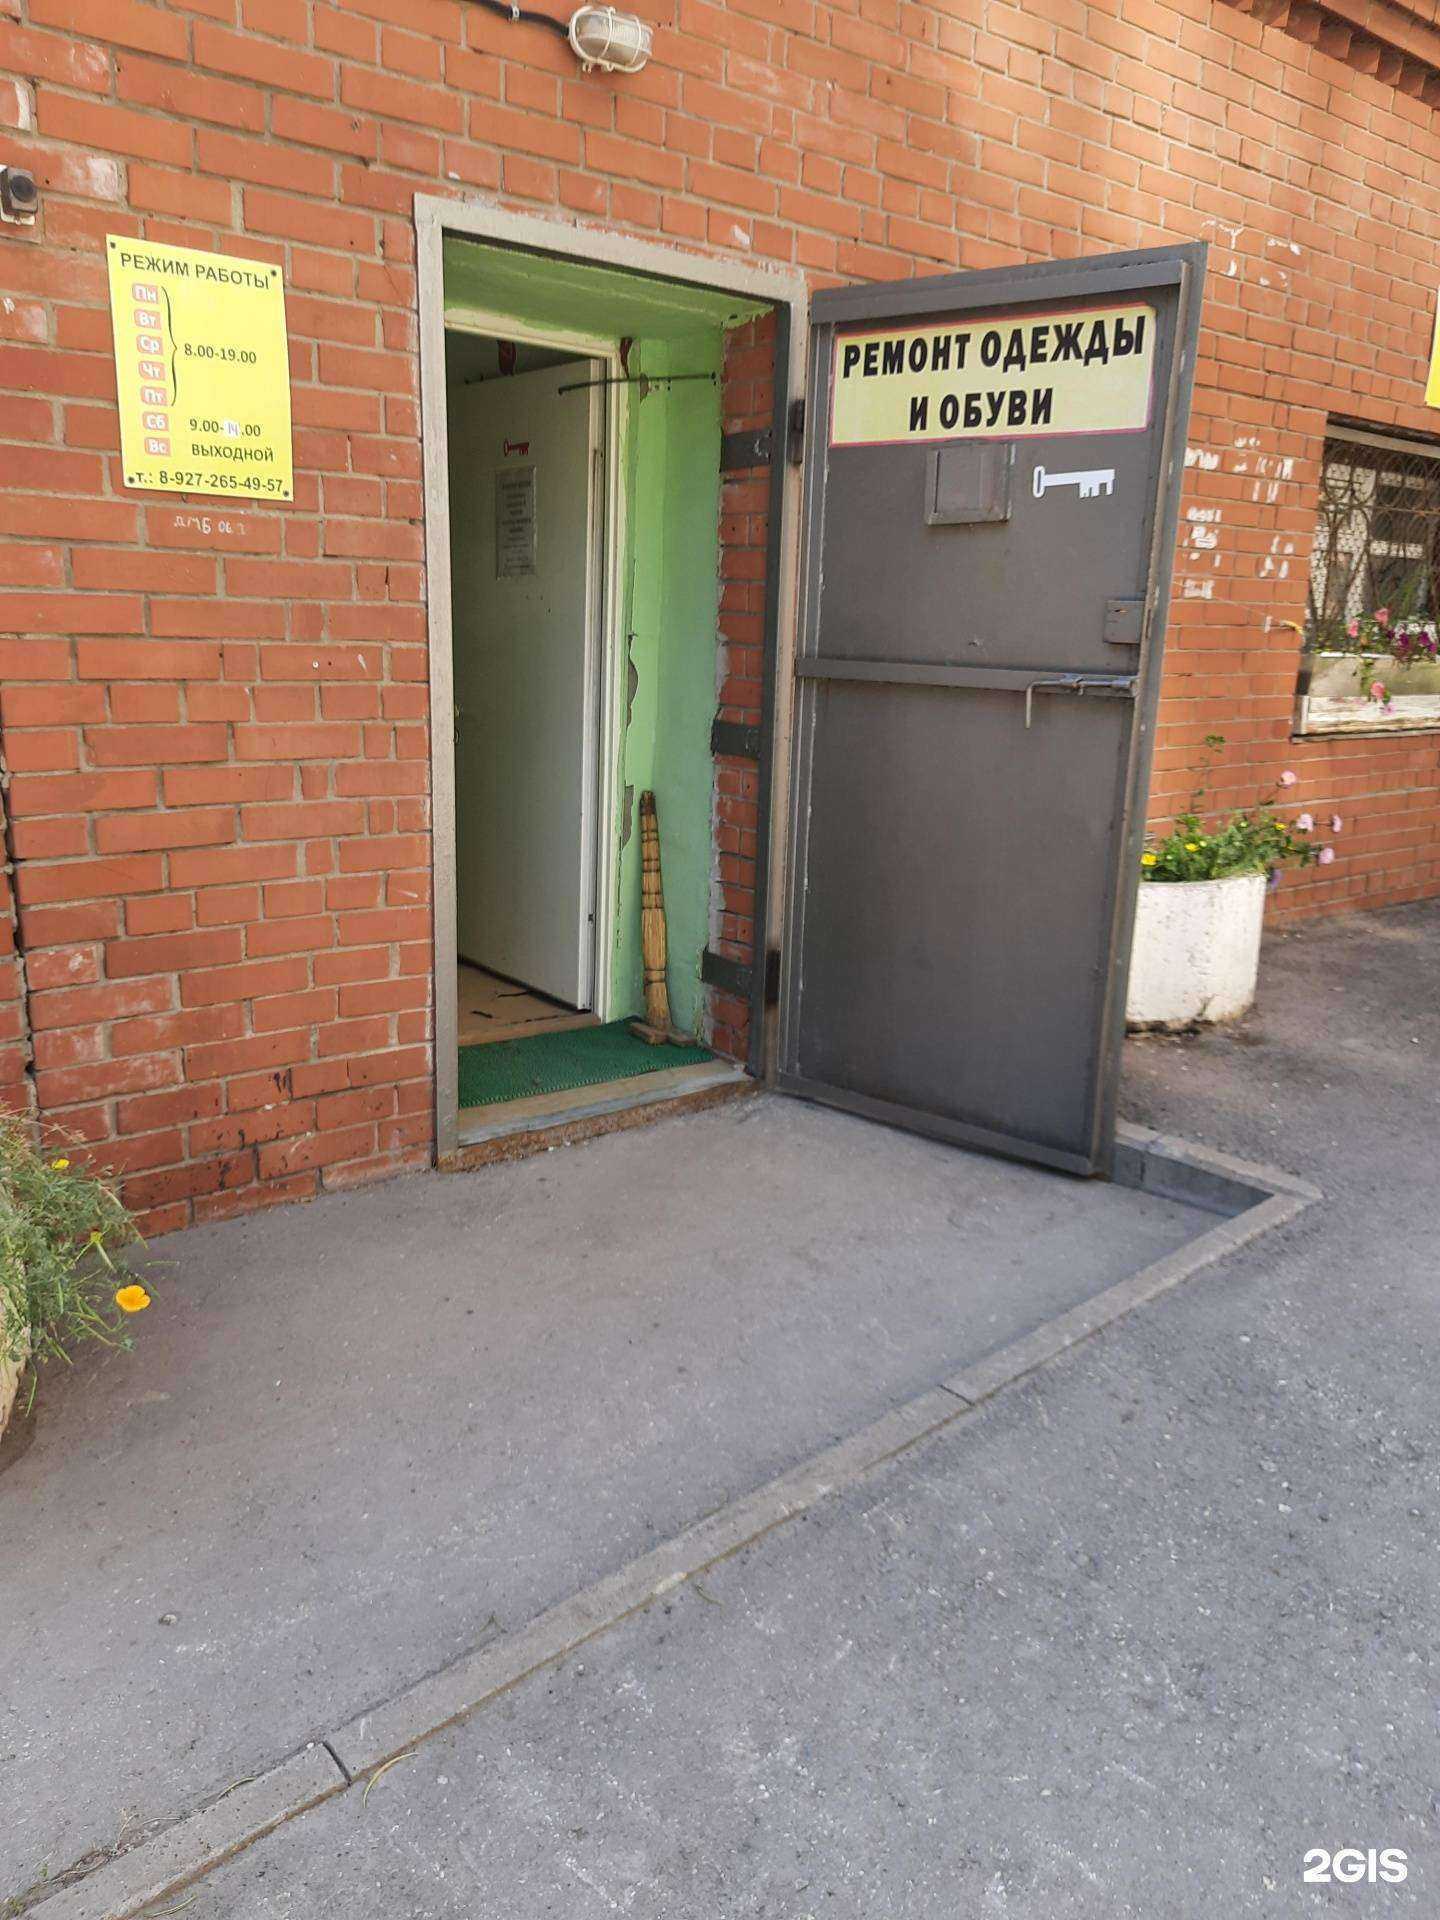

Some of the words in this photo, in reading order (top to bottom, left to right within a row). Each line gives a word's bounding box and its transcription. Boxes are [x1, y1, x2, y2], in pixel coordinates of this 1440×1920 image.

[120, 252, 190, 277] РЕЖИМ
[195, 264, 270, 290] РАБОТЫ
[135, 285, 157, 302] Пн
[139, 310, 158, 327] Вт
[140, 336, 160, 354] Ср
[184, 343, 257, 364] 8.00-19.00
[843, 332, 971, 379] РЕМОНТ
[980, 314, 1146, 374] ОДЕЖДЫ
[142, 362, 161, 379] Чт
[908, 396, 929, 432] И
[939, 387, 1053, 430] ОБУВИ
[146, 414, 166, 430] Сб
[148, 439, 167, 455] Вс
[191, 443, 274, 463] ВЫХОДНОЙ
[159, 470, 283, 492] 8-927-265-49-57
